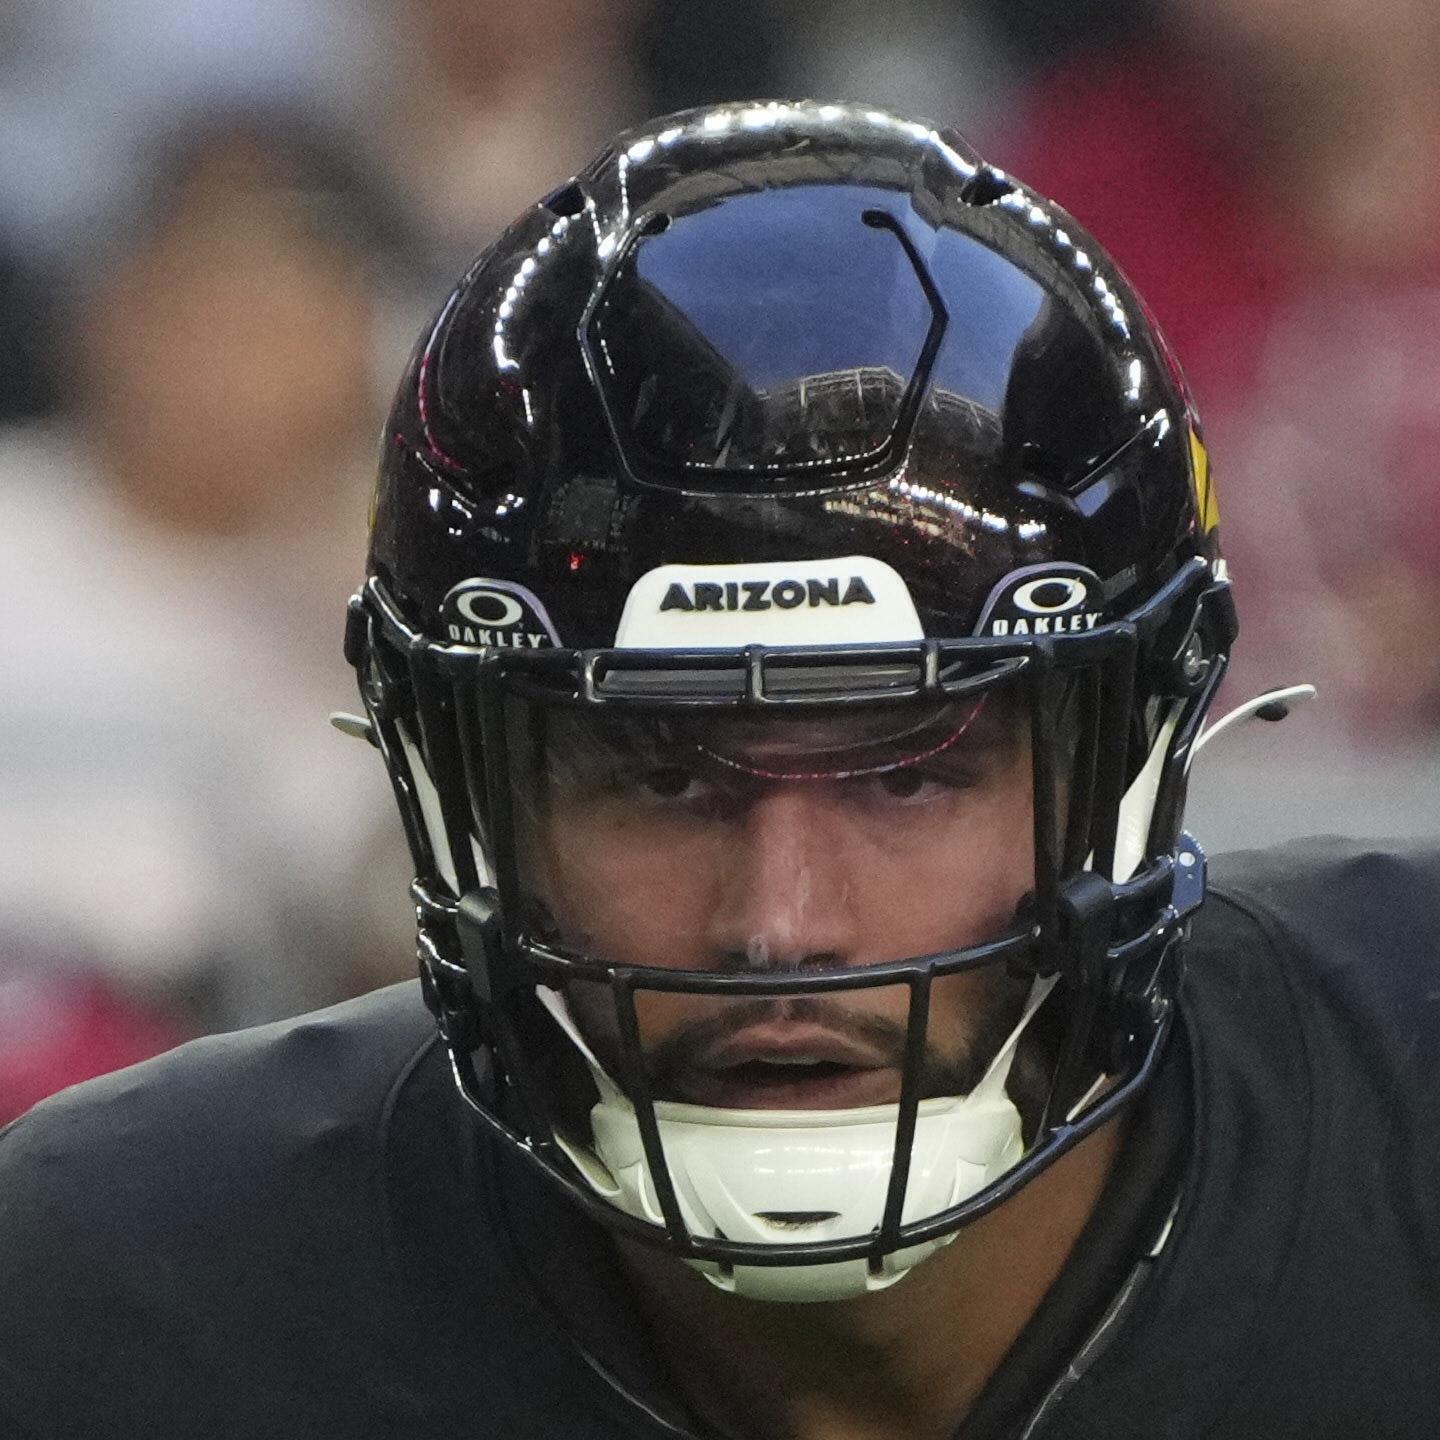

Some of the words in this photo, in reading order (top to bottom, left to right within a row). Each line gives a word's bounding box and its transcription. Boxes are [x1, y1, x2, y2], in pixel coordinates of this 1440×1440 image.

[658, 575, 877, 612] ARIZONA
[448, 623, 548, 650] OAKLEY
[992, 613, 1103, 638] OAKLEY
